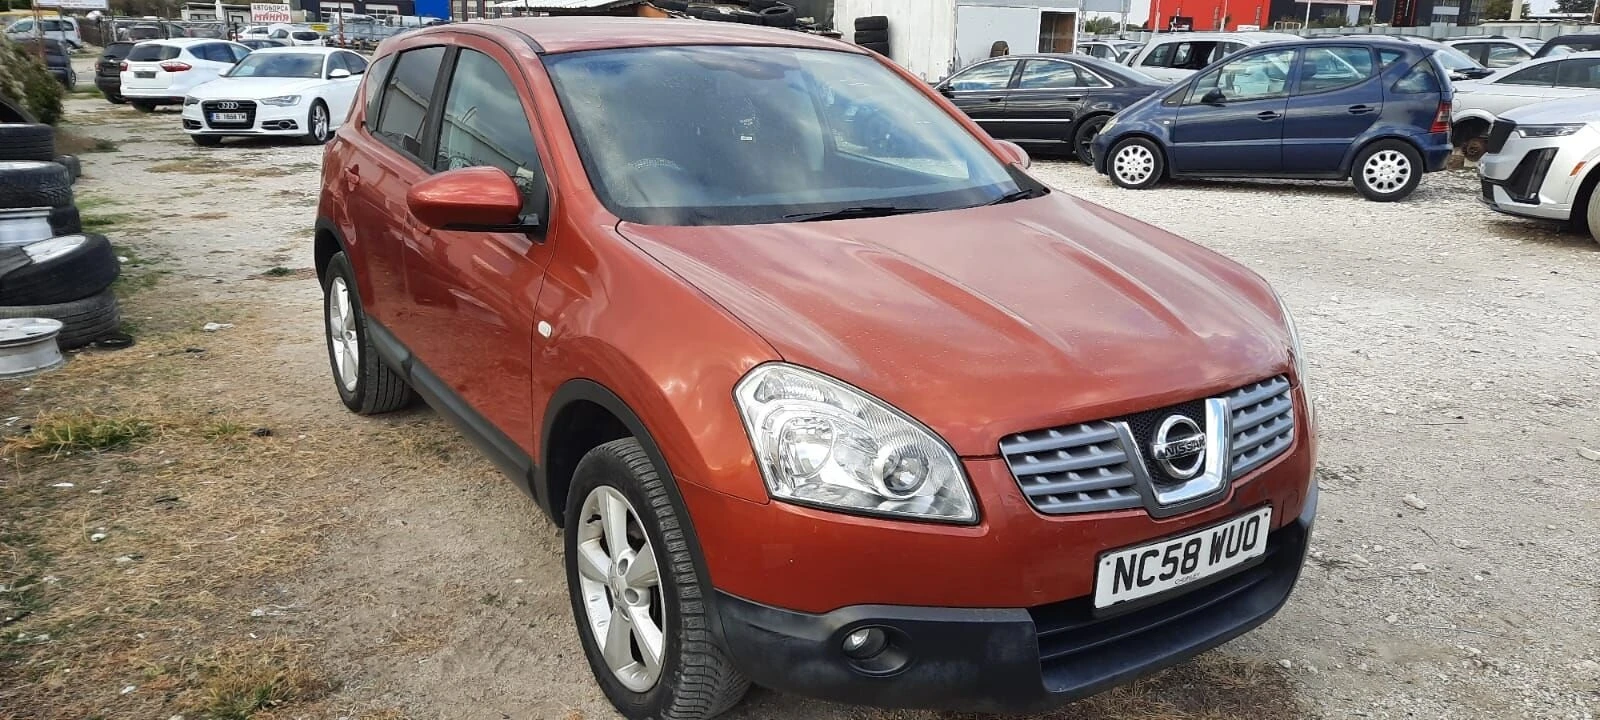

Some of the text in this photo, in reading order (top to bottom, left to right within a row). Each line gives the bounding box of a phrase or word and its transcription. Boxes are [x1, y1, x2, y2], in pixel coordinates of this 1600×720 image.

[1165, 436, 1206, 457] NISSAN
[1113, 514, 1260, 595] NC58 WUO
